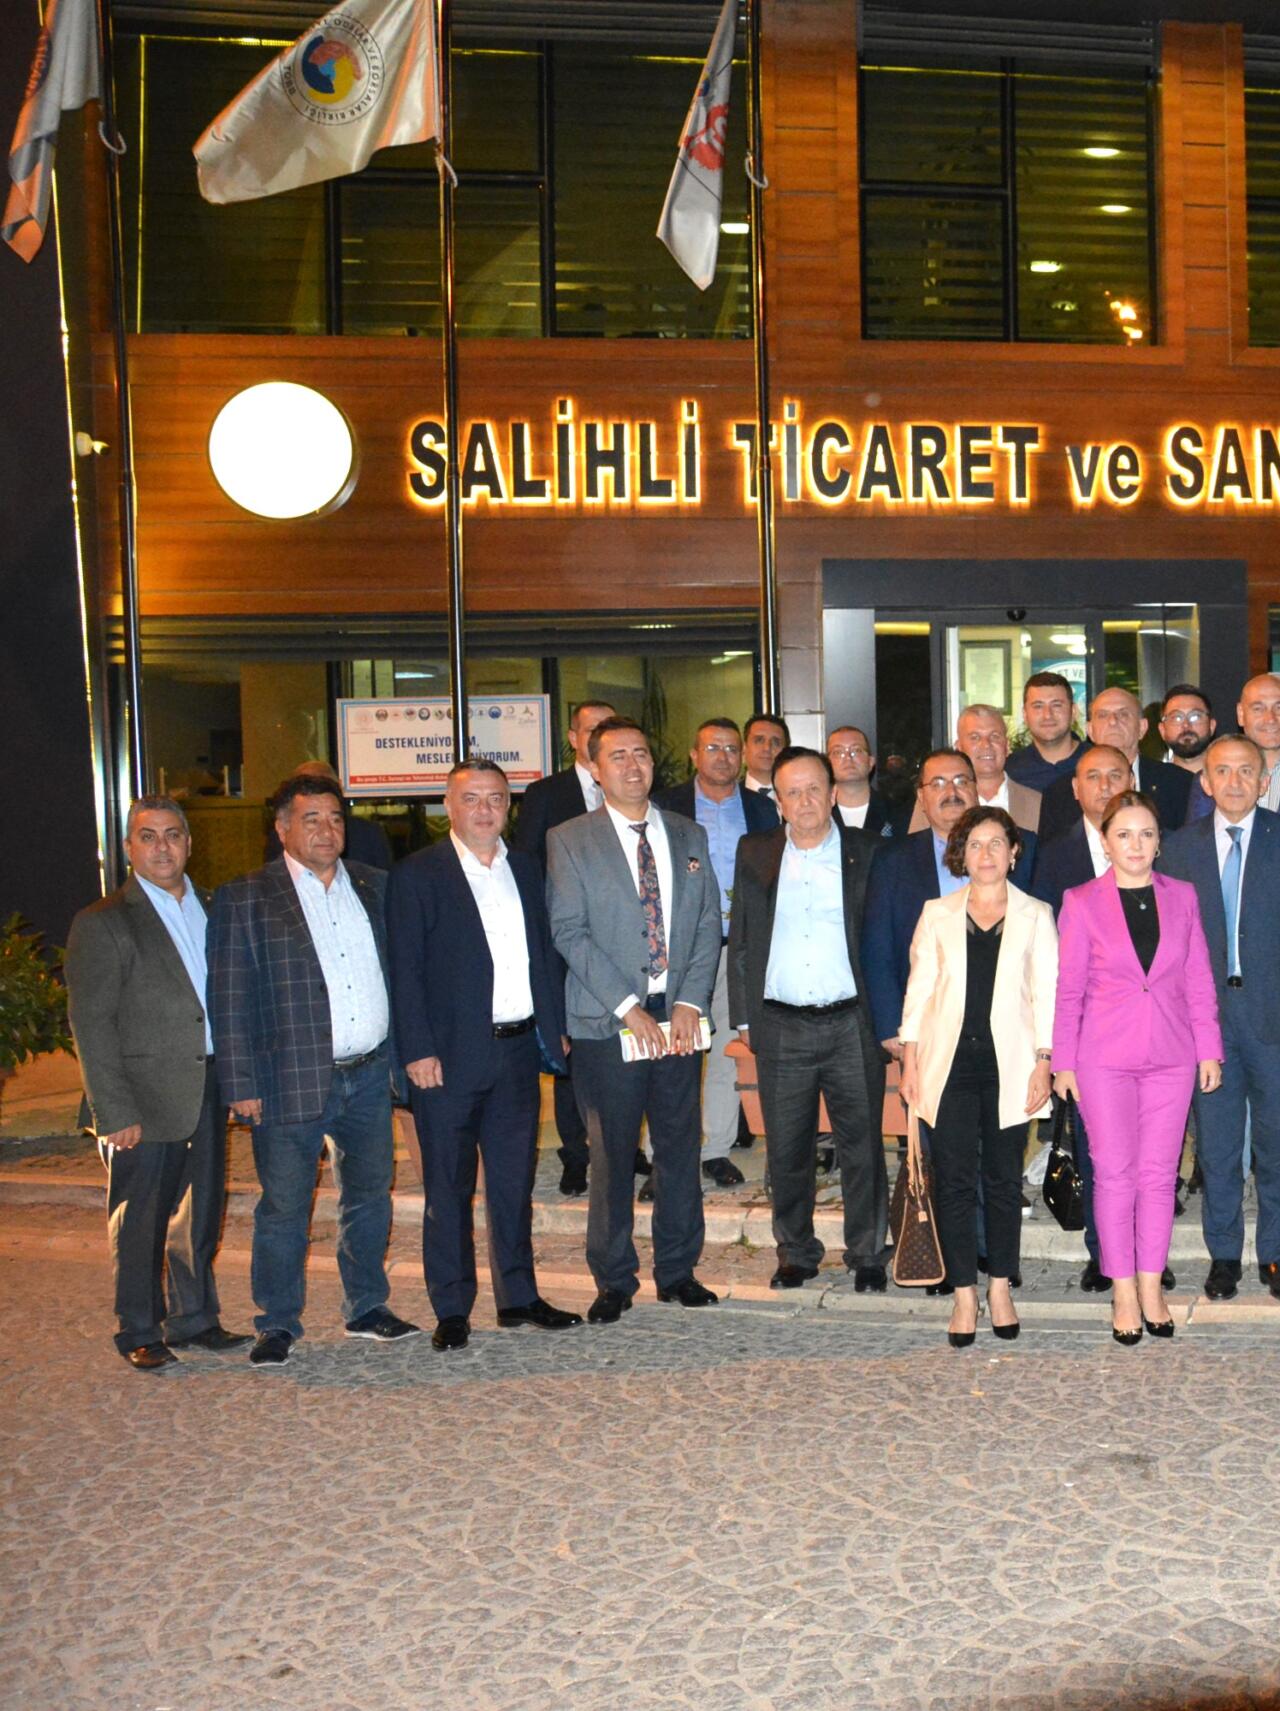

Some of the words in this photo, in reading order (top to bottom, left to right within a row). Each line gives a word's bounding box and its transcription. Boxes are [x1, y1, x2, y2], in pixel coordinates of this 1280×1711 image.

[409, 398, 699, 501] SALİHLİ
[734, 401, 1039, 502] TİCARET
[1066, 443, 1141, 501] ve
